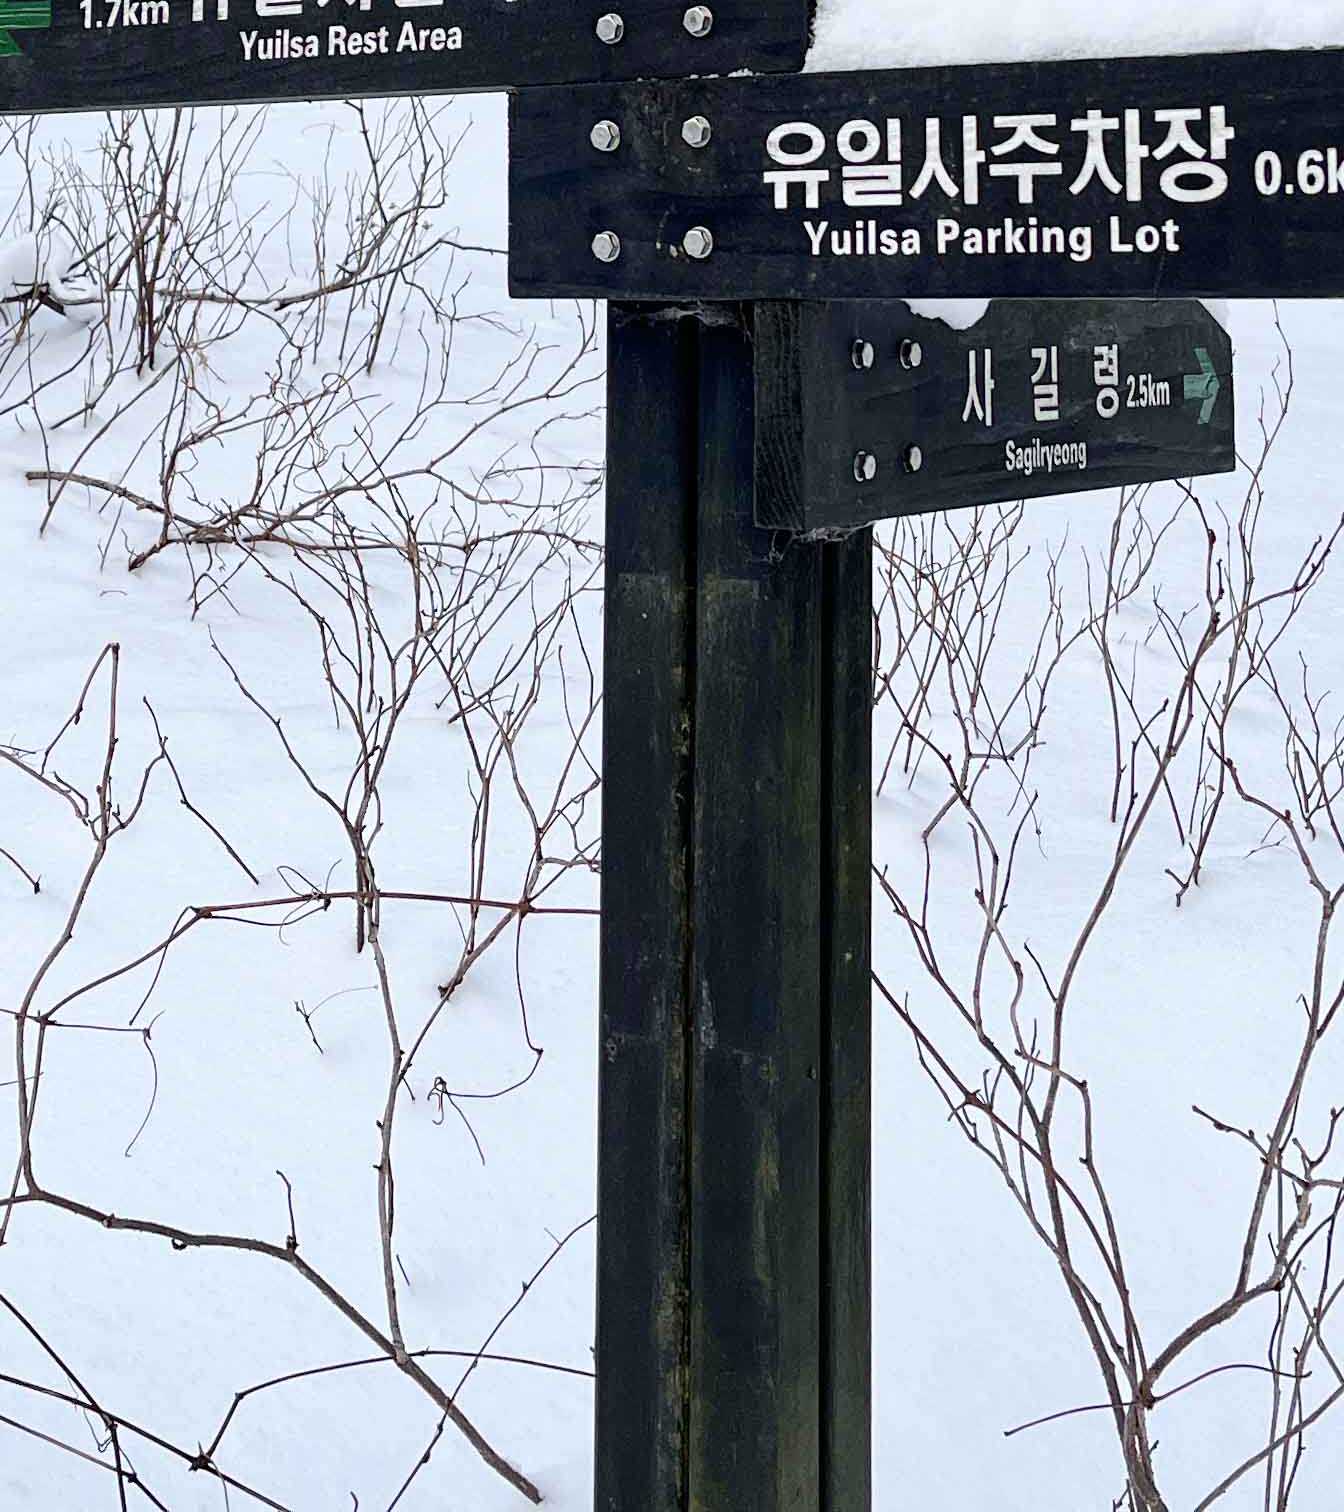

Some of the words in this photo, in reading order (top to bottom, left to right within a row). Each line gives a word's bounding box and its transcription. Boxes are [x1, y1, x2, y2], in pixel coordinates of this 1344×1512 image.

[239, 28, 319, 61] Yuilsa
[327, 25, 390, 56] Rest
[395, 20, 463, 53] Area
[762, 105, 1235, 210] 유일사주차장
[803, 219, 921, 256] Yuilsa
[936, 216, 1092, 262] Parking
[1109, 215, 1180, 253] Lot
[1126, 373, 1171, 408] 2.5km
[1005, 437, 1087, 476] Sagilryeong
